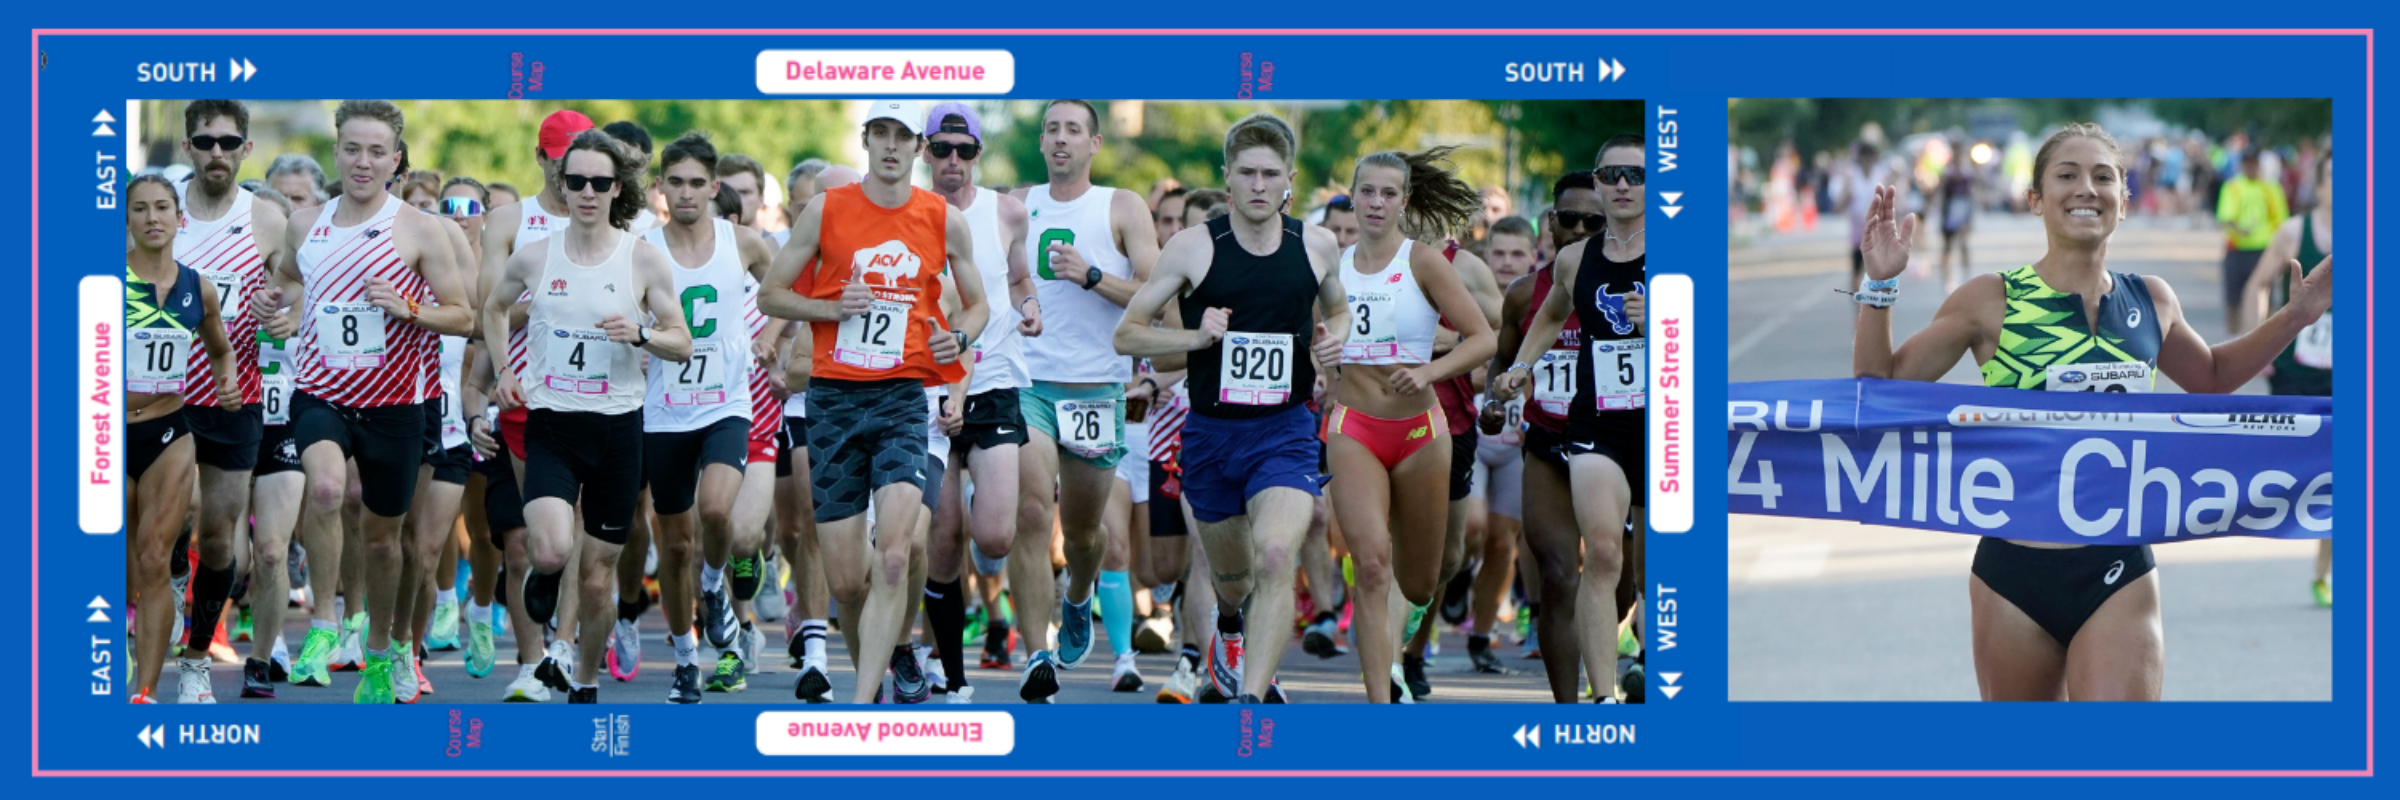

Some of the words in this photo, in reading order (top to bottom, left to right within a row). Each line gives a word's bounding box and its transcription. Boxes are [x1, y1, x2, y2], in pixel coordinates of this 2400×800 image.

[217, 283, 231, 312] 7
[679, 284, 717, 339] C
[341, 314, 359, 347] 8
[860, 312, 891, 347] 12
[1356, 303, 1371, 336] 3
[152, 333, 188, 341] SUBARU
[571, 333, 608, 342] SUBARU
[1252, 338, 1289, 346] SUBARU
[144, 340, 175, 372] 10
[568, 341, 586, 372] 4
[678, 355, 708, 385] 27
[1230, 346, 1284, 382] 920
[1616, 353, 1635, 387] 5
[1543, 362, 1571, 393] 11
[2090, 370, 2145, 381] SUBARU
[1071, 410, 1101, 441] 26
[1728, 400, 1823, 432] RU
[1728, 431, 1783, 510] 4
[1820, 431, 2015, 529] Mile
[2058, 437, 2333, 537] Chase
